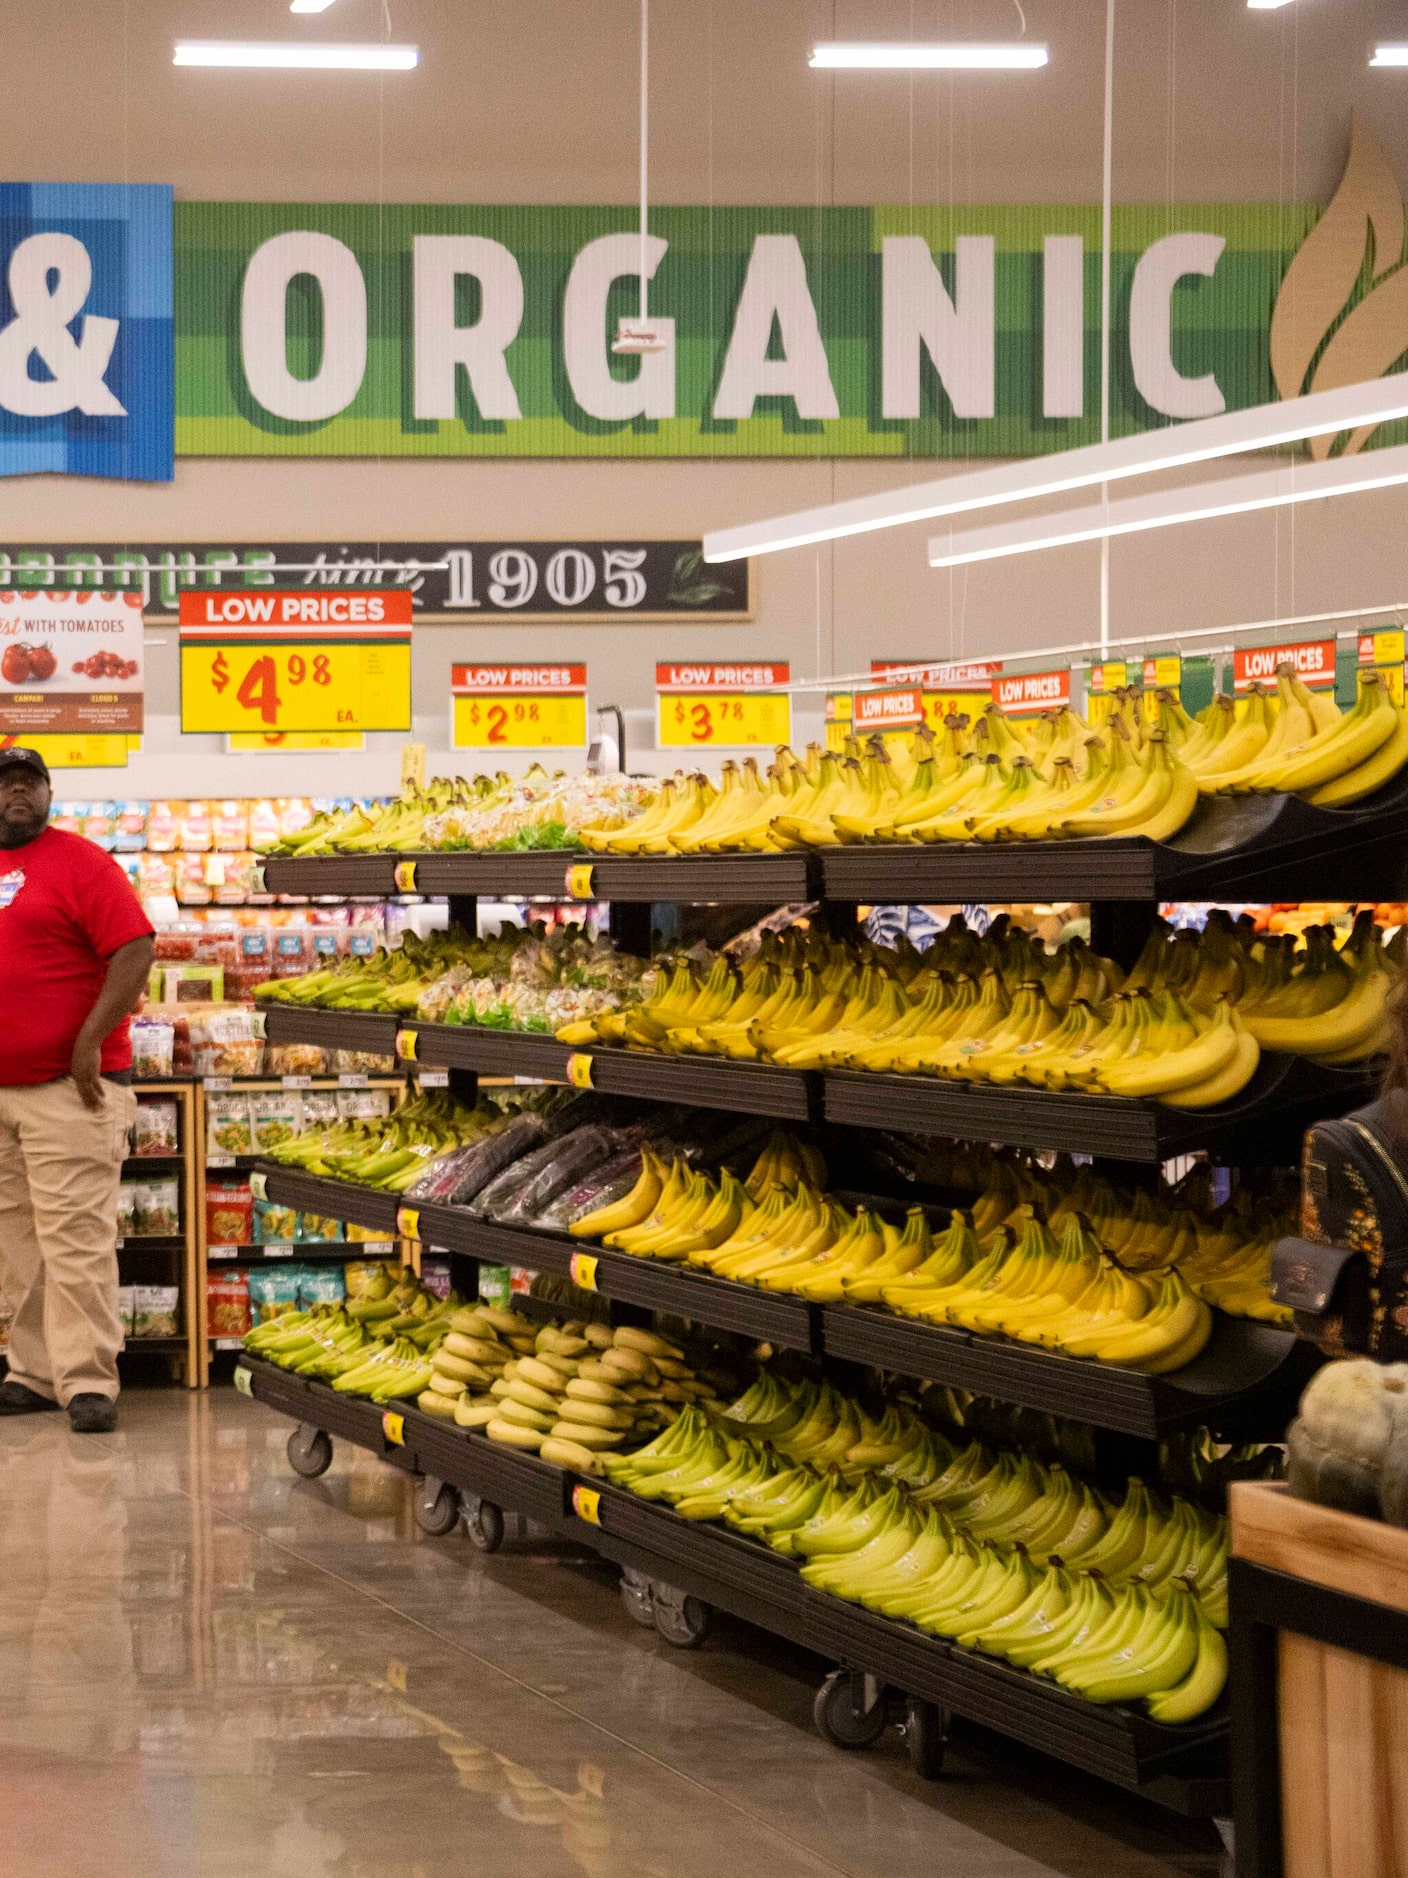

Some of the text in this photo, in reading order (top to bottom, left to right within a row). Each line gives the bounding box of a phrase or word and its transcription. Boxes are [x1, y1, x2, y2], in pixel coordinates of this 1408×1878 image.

[241, 229, 1227, 421] ORGANIC
[442, 548, 647, 609] 1905
[205, 597, 385, 622] LOW PRICES
[25, 619, 56, 633] WITH
[61, 619, 125, 633] TOMATOES
[1245, 646, 1324, 677] LOW PRICES
[466, 669, 572, 685] LOW PRICES
[671, 668, 775, 684] LOW PRICES
[999, 676, 1061, 702] LOW PRICES
[337, 710, 359, 724] EA.
[861, 693, 914, 718] LOW PRICES
